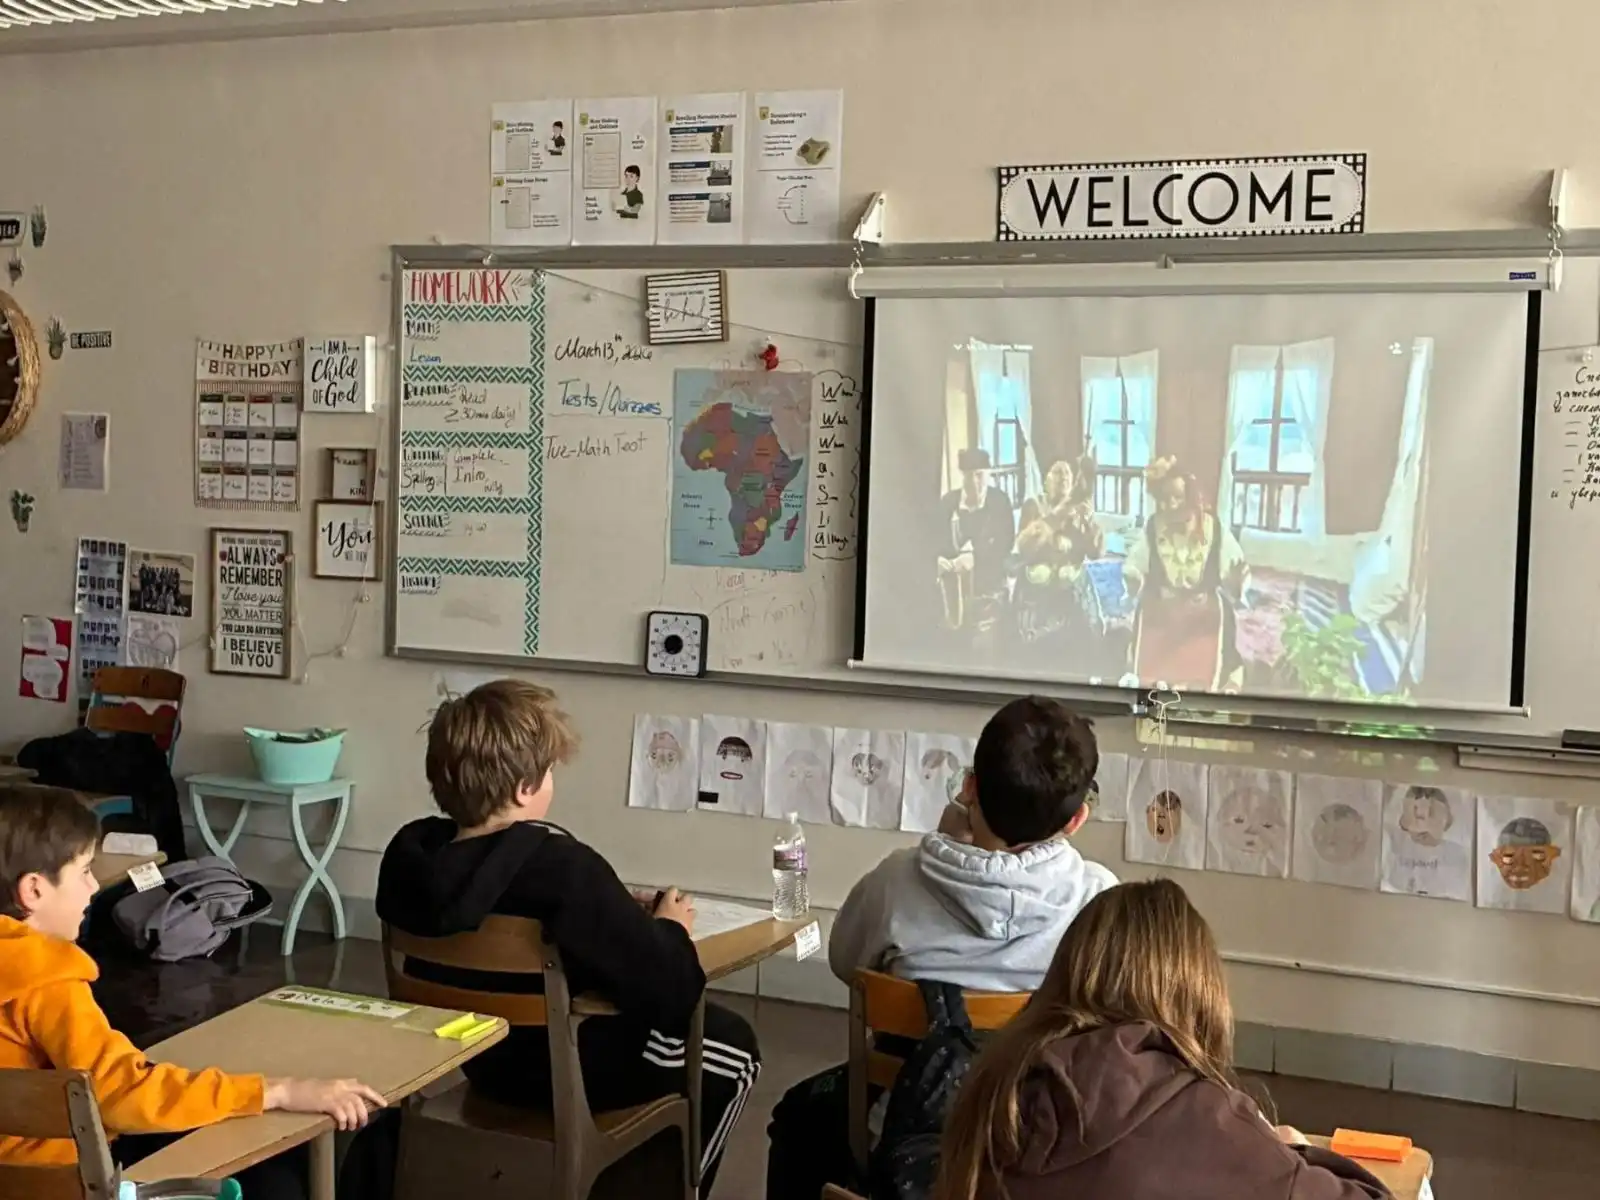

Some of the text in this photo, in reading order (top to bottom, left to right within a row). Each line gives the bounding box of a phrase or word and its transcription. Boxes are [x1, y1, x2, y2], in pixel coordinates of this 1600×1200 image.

[1027, 168, 1335, 228] WELCOME
[411, 270, 511, 305] HOMEWORK
[222, 344, 276, 361] HAPPY
[328, 341, 340, 354] AM
[341, 341, 348, 354] A
[209, 360, 291, 378] BIRTHDAY
[312, 355, 362, 383] Child
[312, 380, 359, 408] OF God
[321, 520, 373, 559] You
[227, 545, 277, 567] ALWAYS
[220, 565, 283, 588] REMEMBER
[234, 586, 257, 601] love
[259, 592, 283, 608] you
[245, 609, 283, 621] MATTER
[230, 638, 282, 655] BELIEVE
[230, 652, 274, 668] IN YOU
